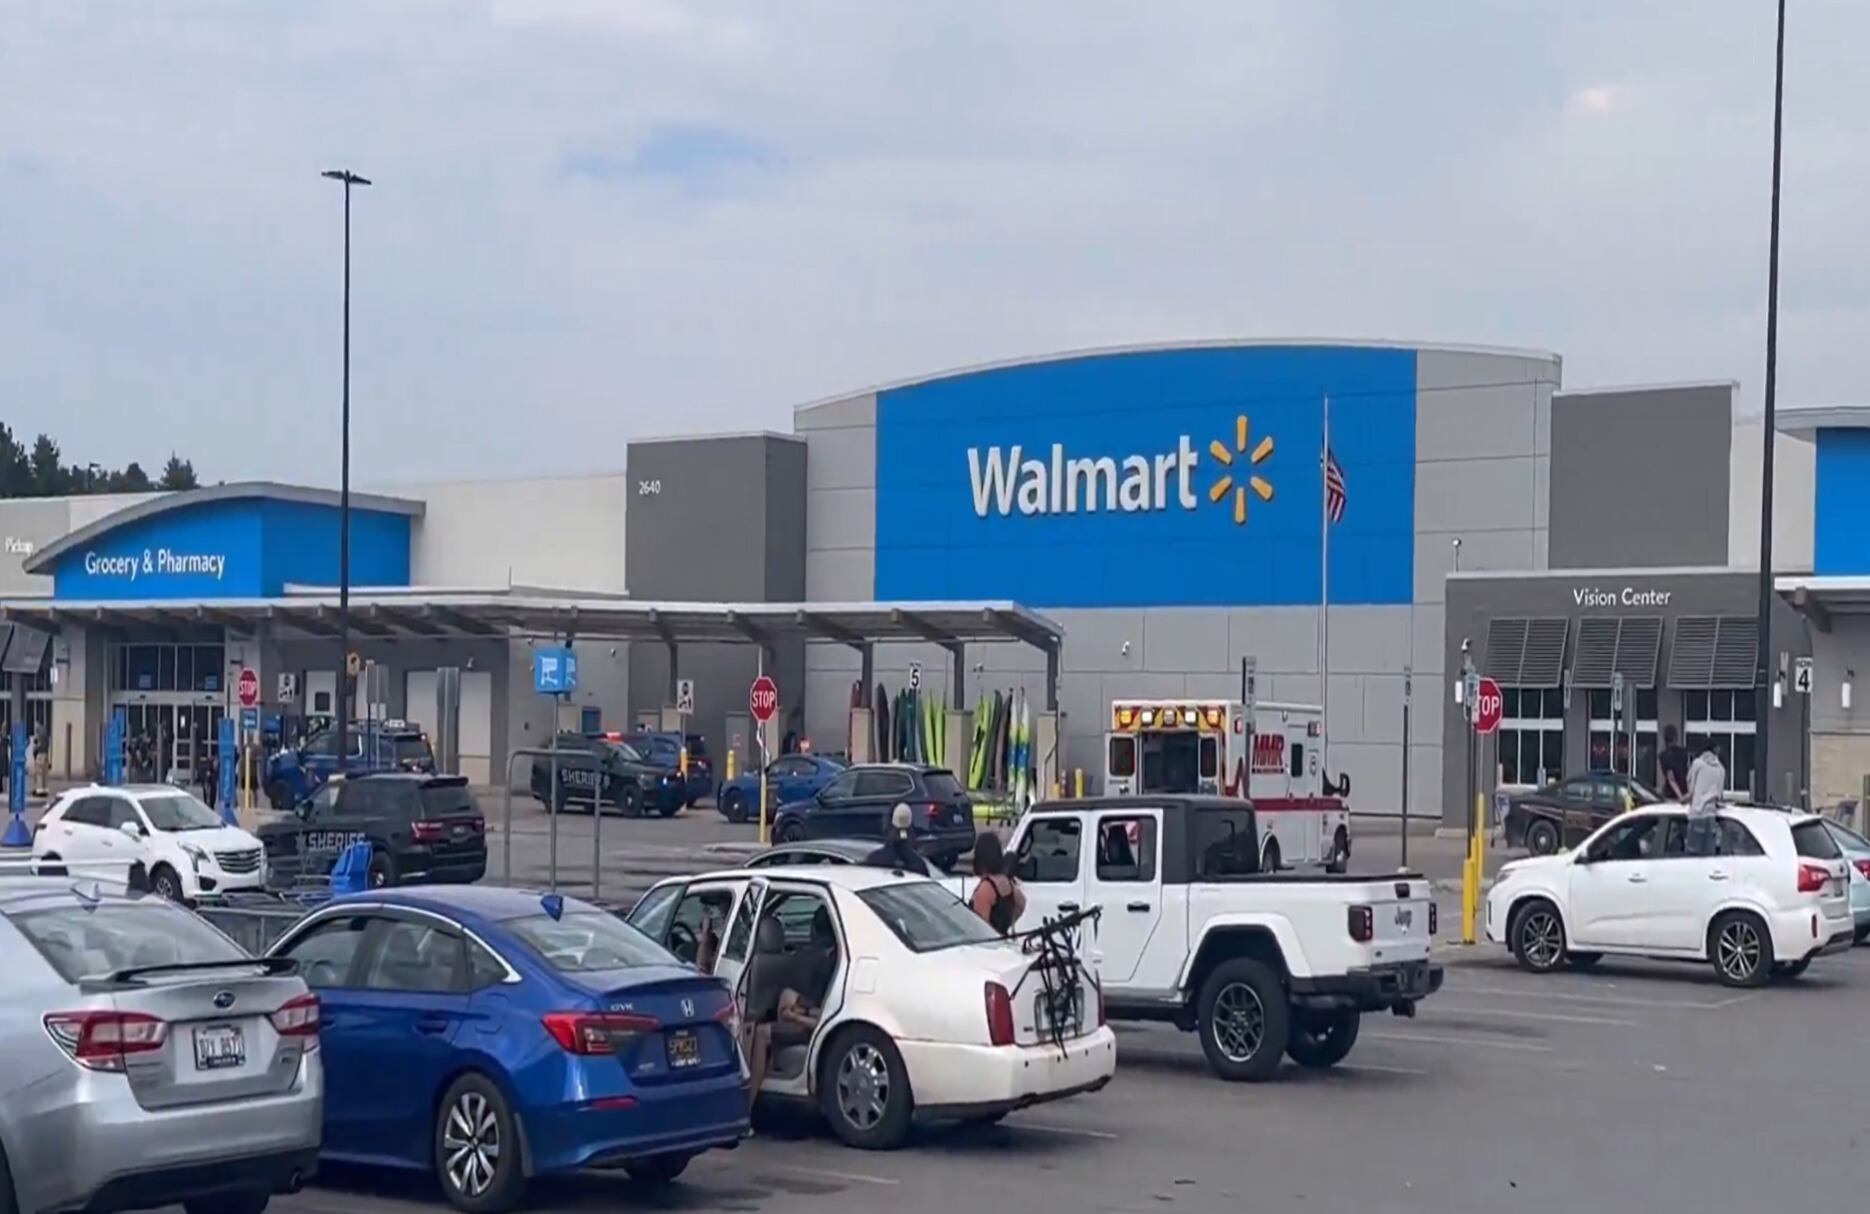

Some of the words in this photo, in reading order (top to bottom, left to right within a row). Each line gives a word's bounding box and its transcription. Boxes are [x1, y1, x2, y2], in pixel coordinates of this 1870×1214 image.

[967, 435, 1198, 517] Walmart
[639, 480, 661, 495] 2640
[85, 552, 139, 582] Grocery
[142, 549, 153, 573] &
[158, 549, 225, 580] Pharmacy
[1573, 588, 1617, 606] Vision
[1621, 588, 1671, 605] Center
[911, 668, 919, 687] 5
[1798, 669, 1810, 691] 4
[752, 690, 775, 708] STOP
[1252, 733, 1285, 766] MMR
